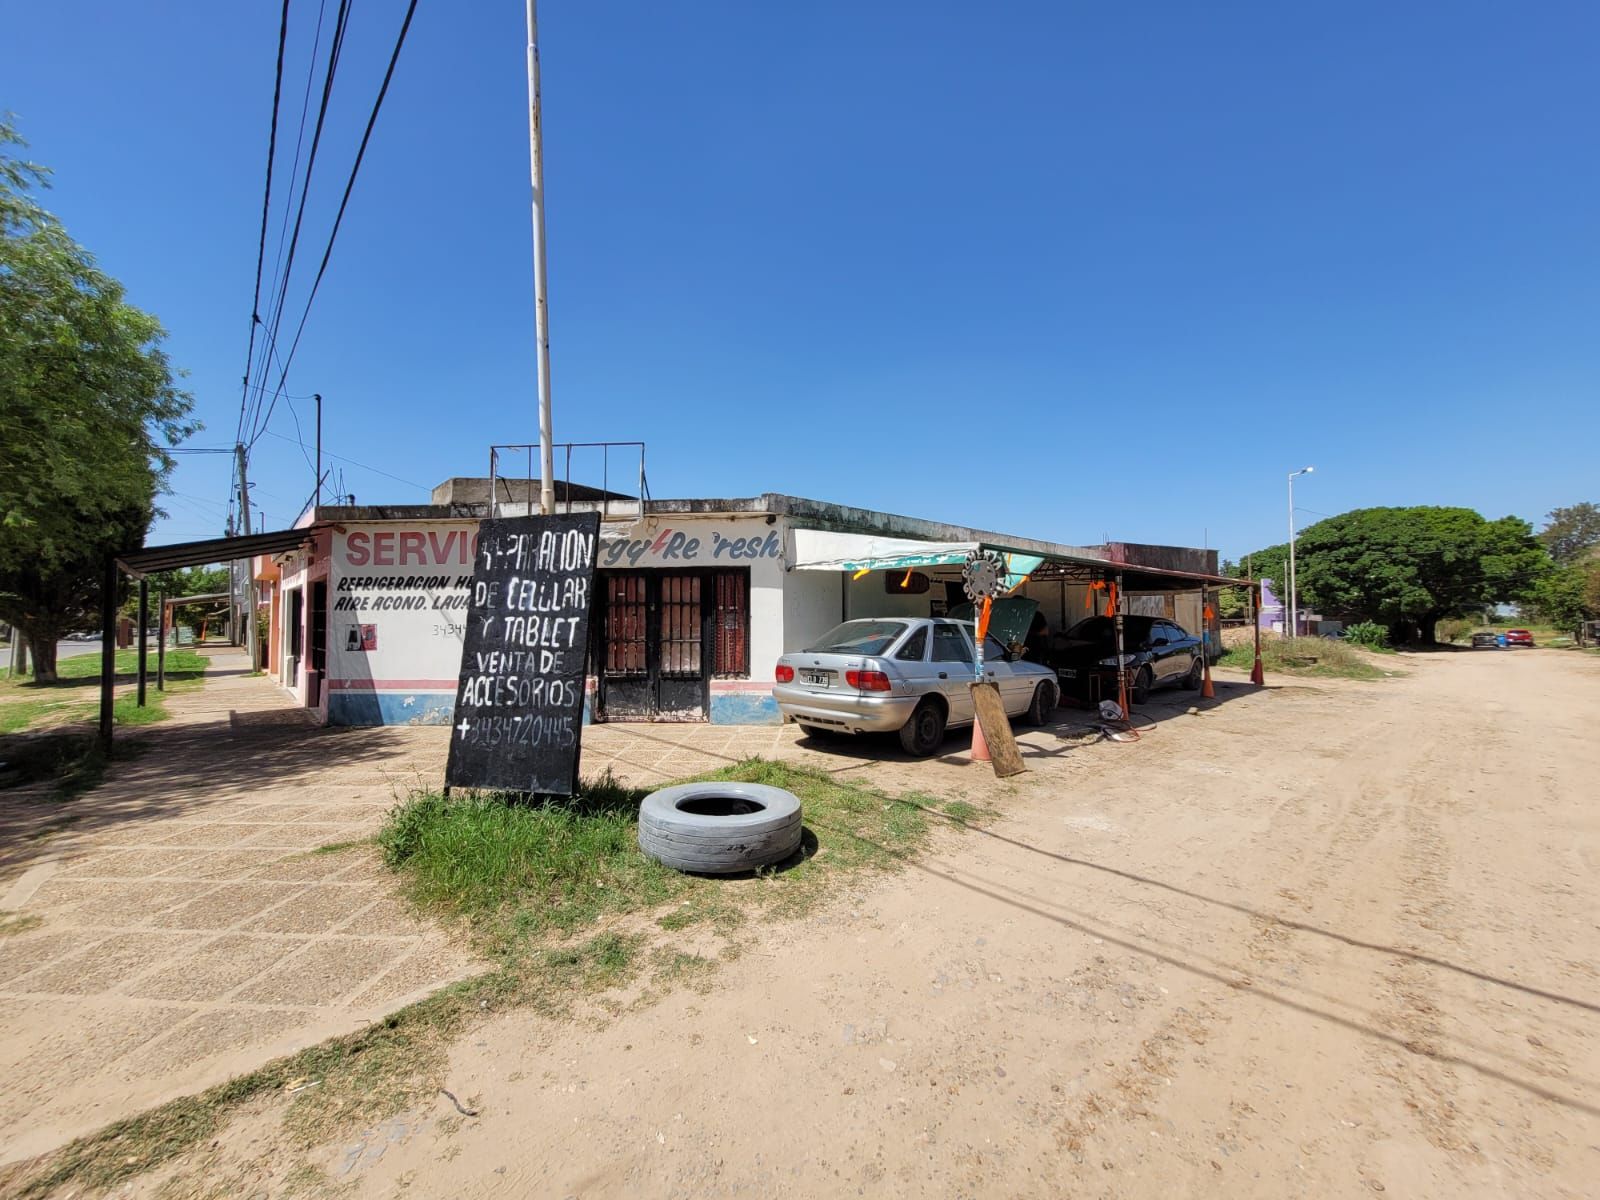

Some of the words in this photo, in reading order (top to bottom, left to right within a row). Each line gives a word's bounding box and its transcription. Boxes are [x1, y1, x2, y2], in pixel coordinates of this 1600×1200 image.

[337, 576, 451, 591] REFRIGERACION
[475, 581, 500, 609] DE
[334, 596, 369, 611] AIRE
[480, 616, 495, 638] Y
[504, 615, 580, 647] TABLET
[477, 651, 535, 674] VENTA
[540, 649, 564, 674] DE
[461, 676, 575, 707] ACCESORIOS
